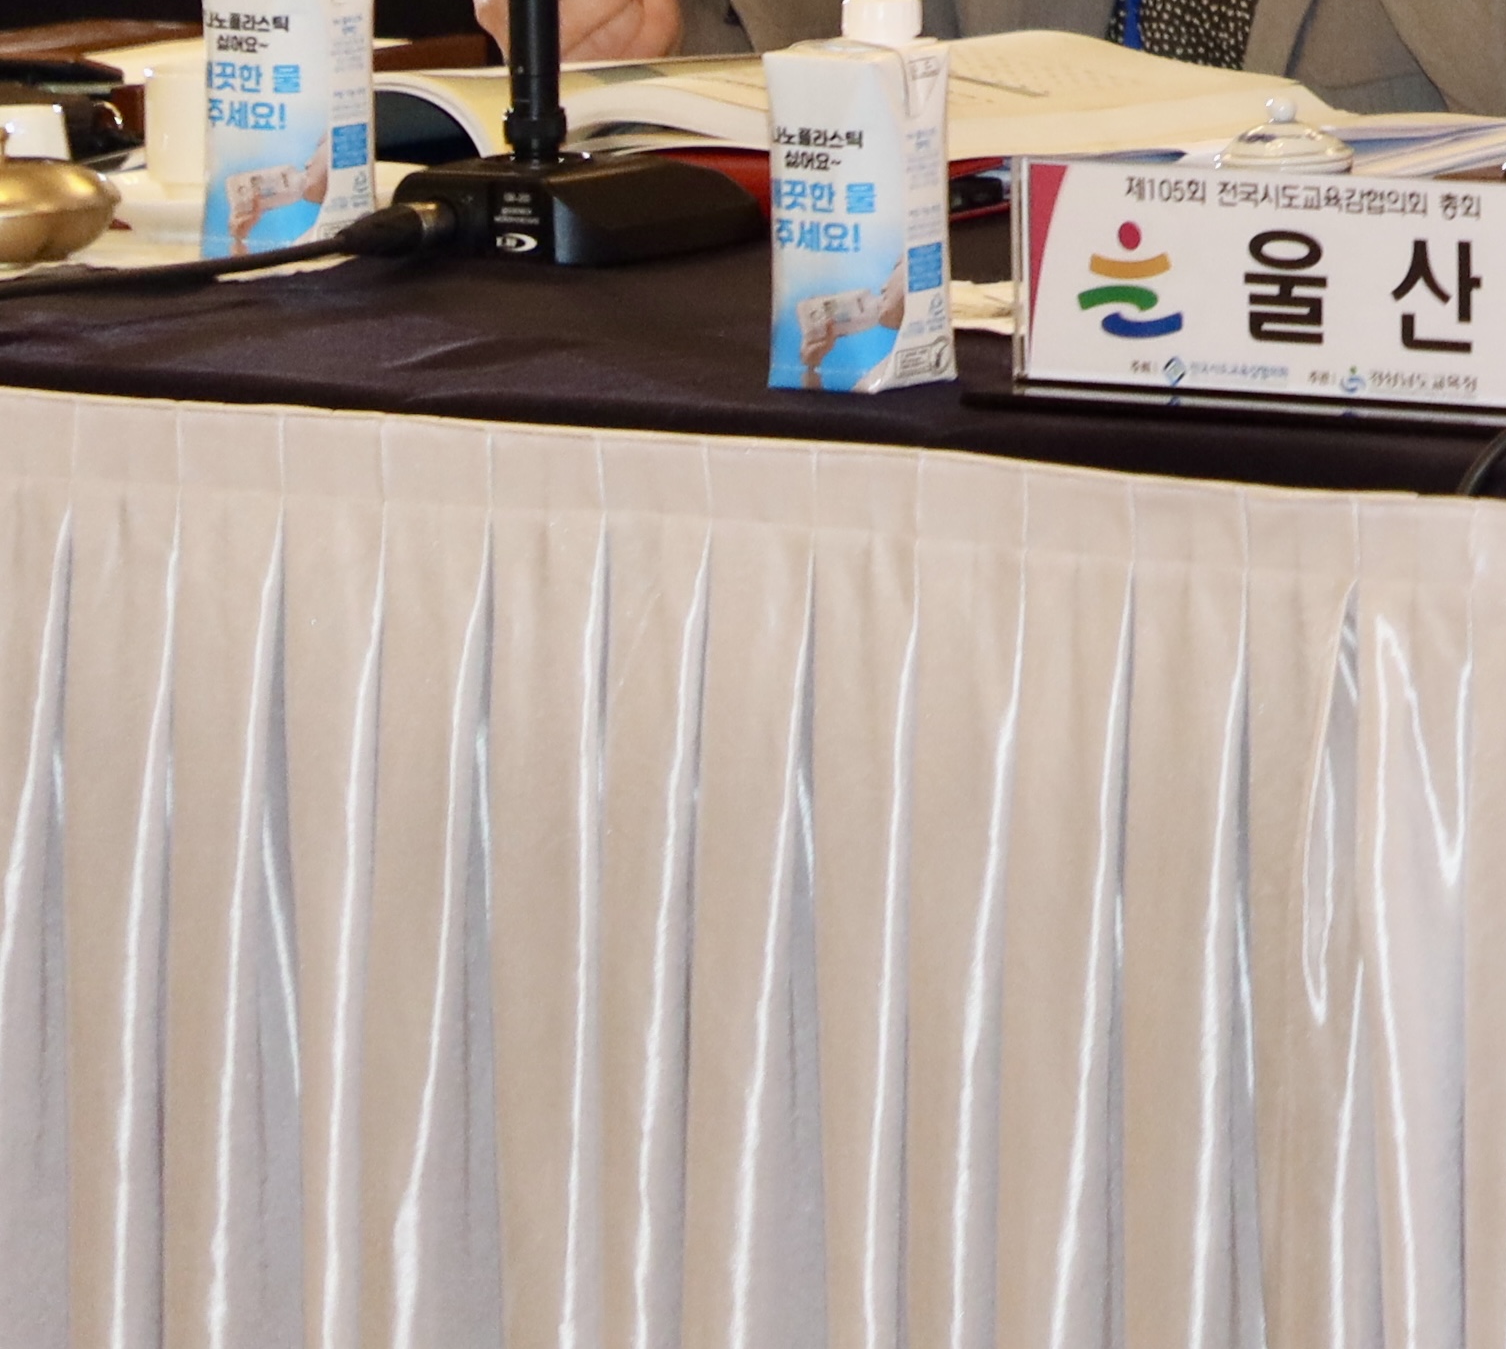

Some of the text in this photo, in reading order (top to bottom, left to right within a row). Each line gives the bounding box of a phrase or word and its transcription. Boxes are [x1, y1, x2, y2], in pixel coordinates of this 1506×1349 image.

[272, 64, 301, 93] 물
[845, 182, 876, 214] 물
[1126, 175, 1481, 220] 제105회 전국시도교육감협의회 총회
